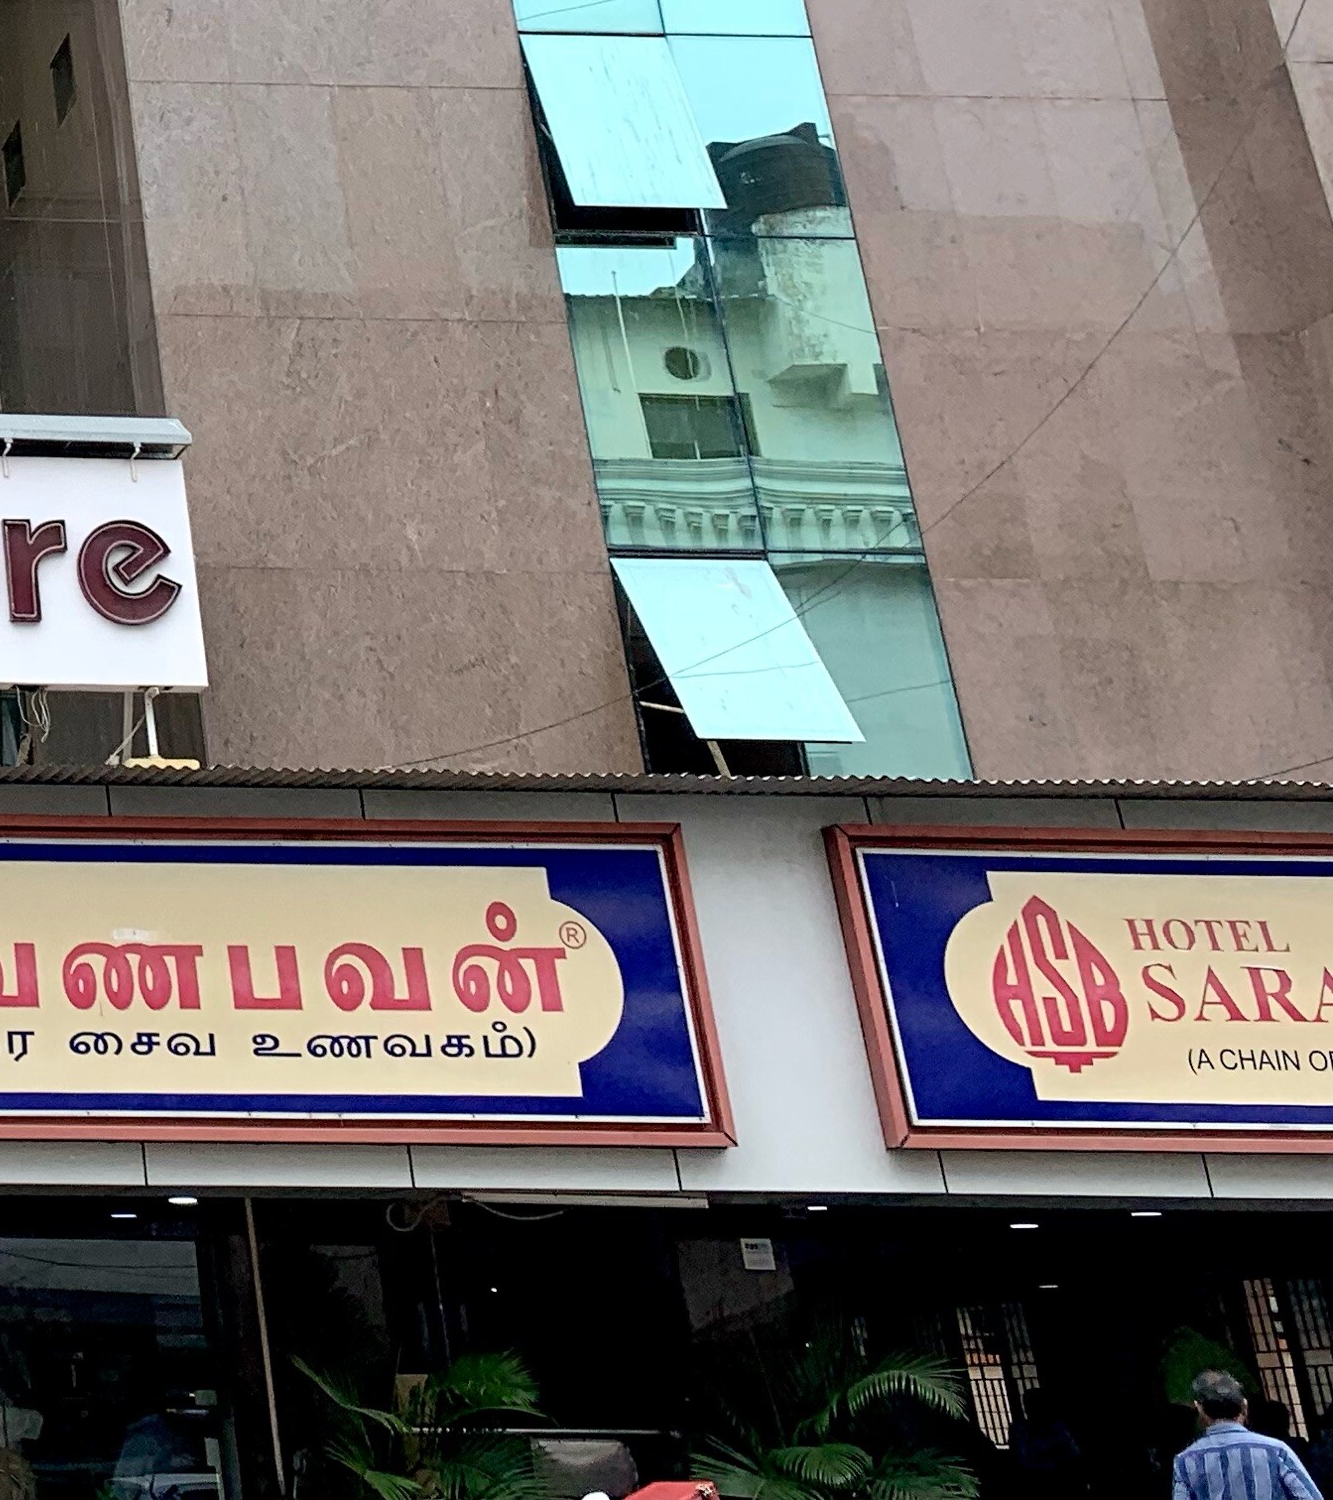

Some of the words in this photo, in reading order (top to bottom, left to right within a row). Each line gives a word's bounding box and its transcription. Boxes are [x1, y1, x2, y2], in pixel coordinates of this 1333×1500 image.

[1123, 918, 1291, 953] HOTEL
[992, 895, 1129, 1047] HSB
[69, 1030, 216, 1059] சைவ
[1188, 1048, 1215, 1076] (A
[1219, 1048, 1301, 1072] CHAIN
